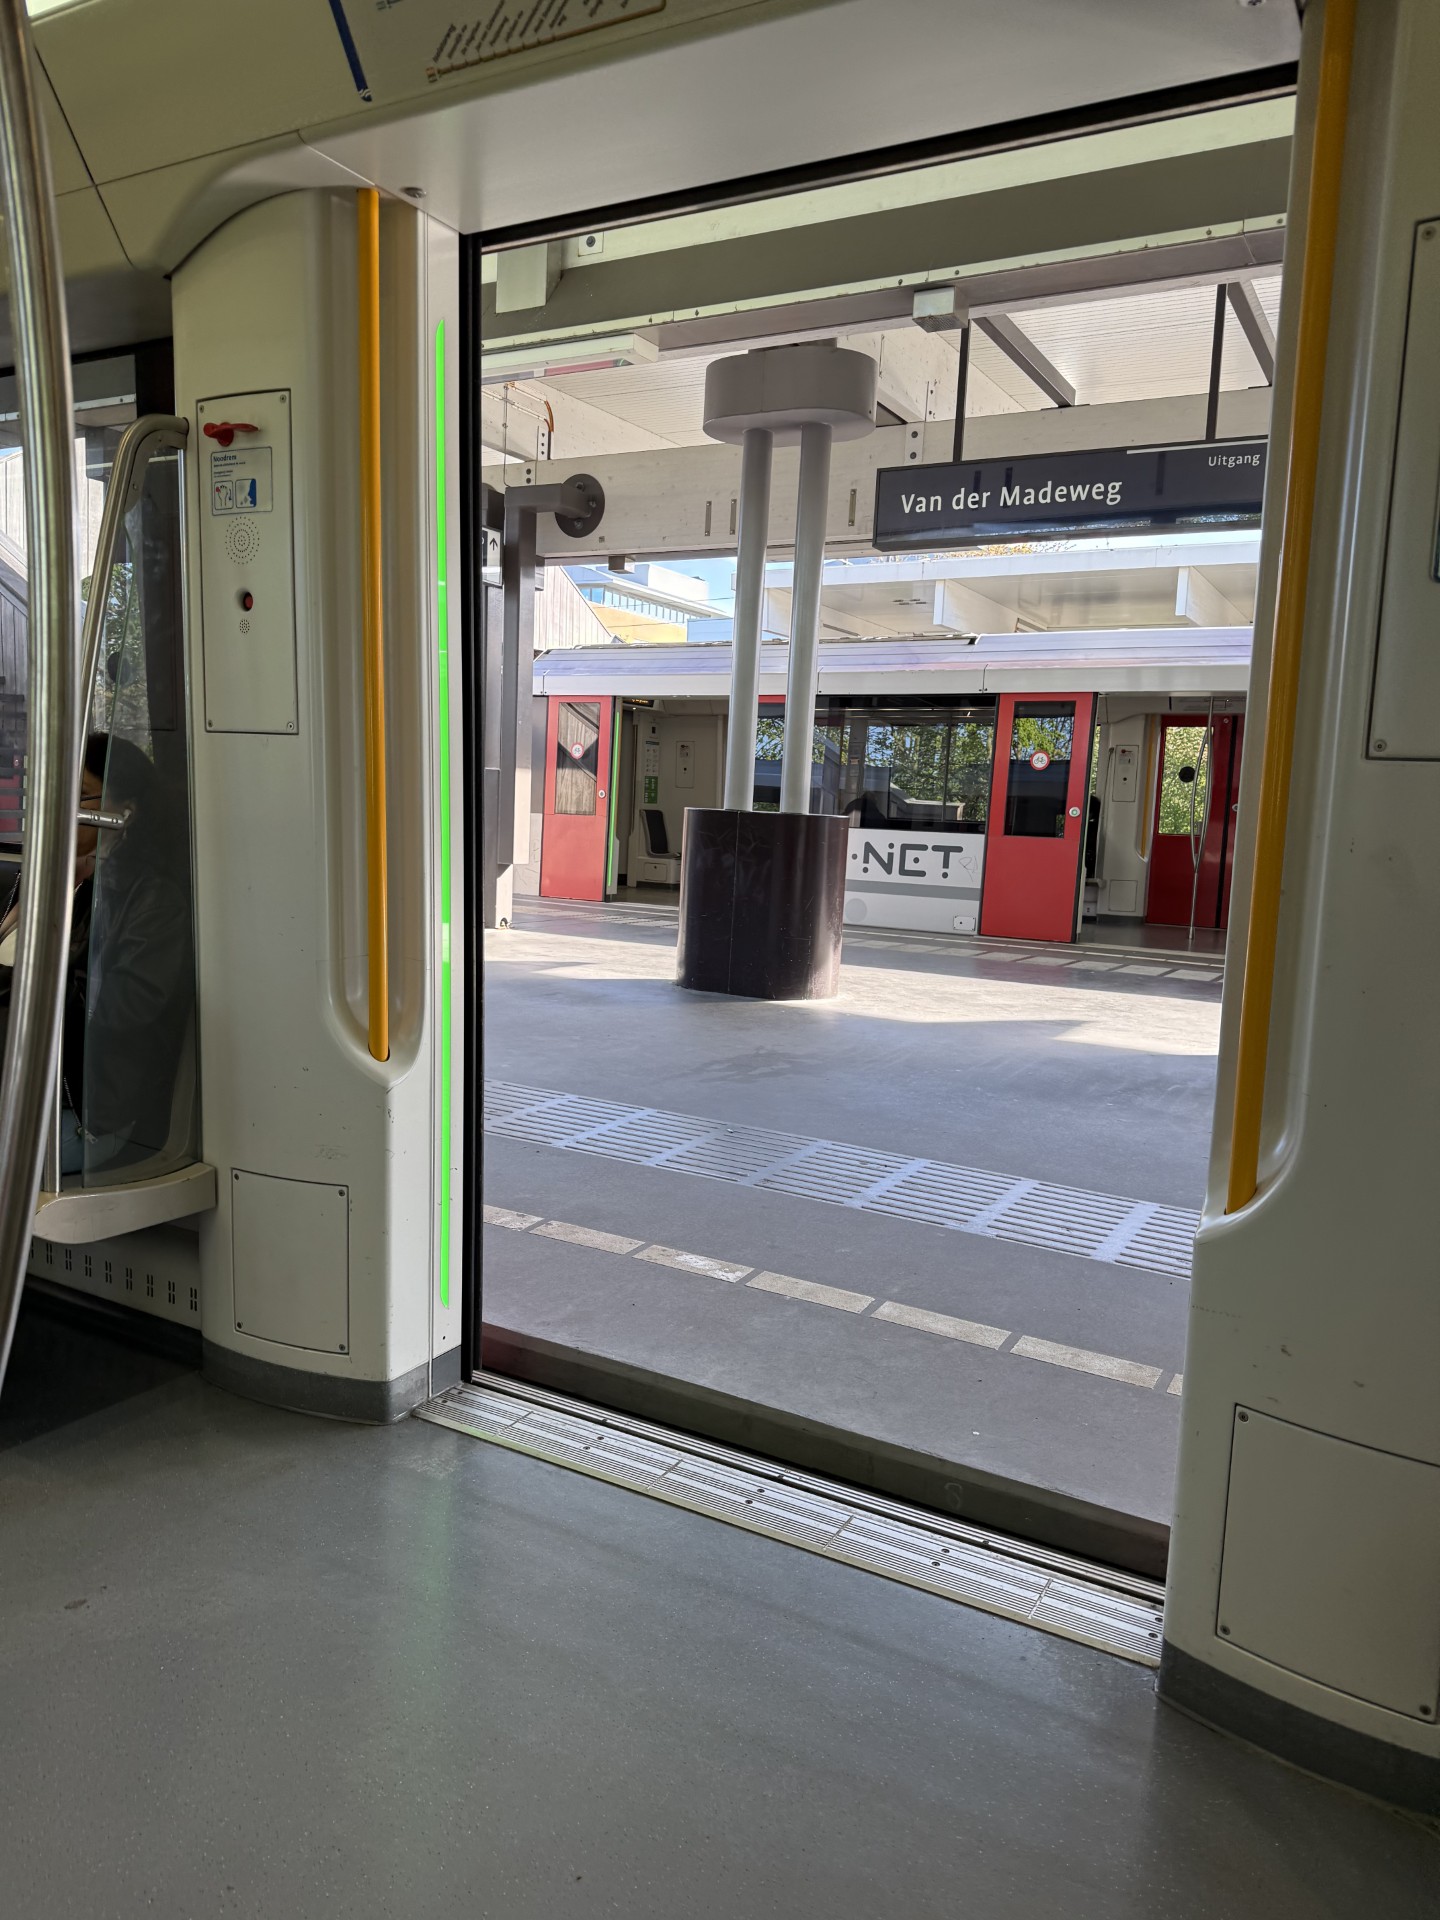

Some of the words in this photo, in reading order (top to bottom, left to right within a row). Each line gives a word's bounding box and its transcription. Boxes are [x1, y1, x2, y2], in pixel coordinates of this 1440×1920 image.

[213, 454, 237, 462] Noodrem
[1207, 452, 1261, 467] Uitgang
[901, 492, 942, 513] Van
[951, 488, 991, 510] der
[1000, 480, 1123, 506] Madeweg
